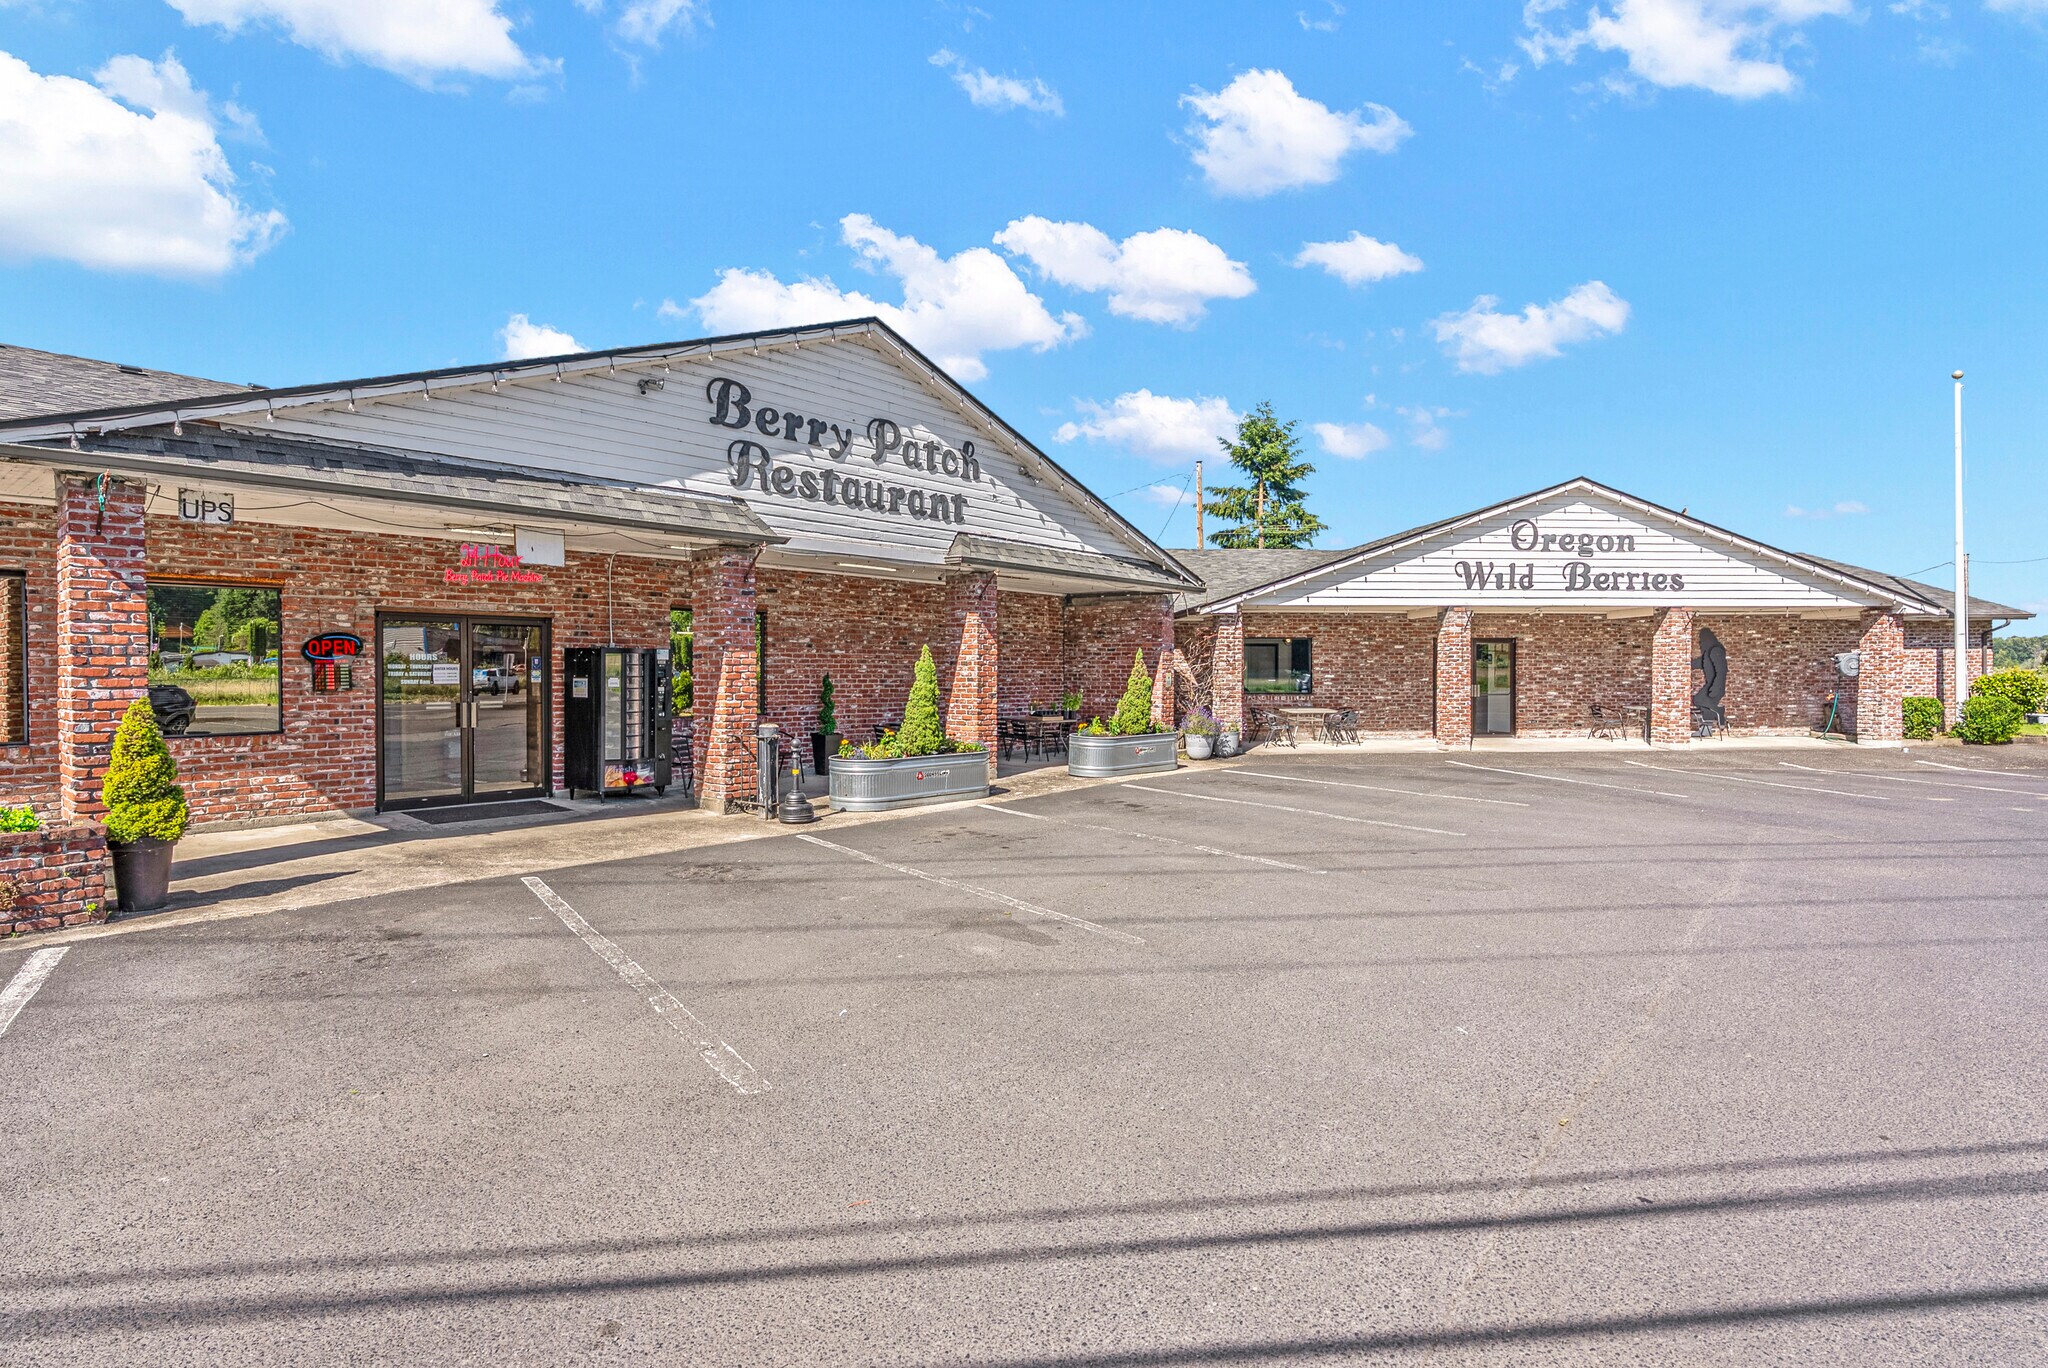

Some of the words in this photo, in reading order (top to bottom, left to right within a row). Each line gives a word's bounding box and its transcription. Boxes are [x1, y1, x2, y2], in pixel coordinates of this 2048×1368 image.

[706, 377, 853, 460] Berry
[866, 417, 981, 482] Patch
[727, 439, 969, 526] Restaurant
[182, 498, 232, 522] UPS
[1510, 518, 1636, 558] Oregon
[443, 568, 469, 586] Berry
[471, 569, 494, 582] Patch
[496, 569, 509, 582] Pie
[510, 569, 543, 583] Machine
[1454, 560, 1535, 591] Wild
[1562, 561, 1685, 592] Berries
[308, 640, 356, 656] OPEN
